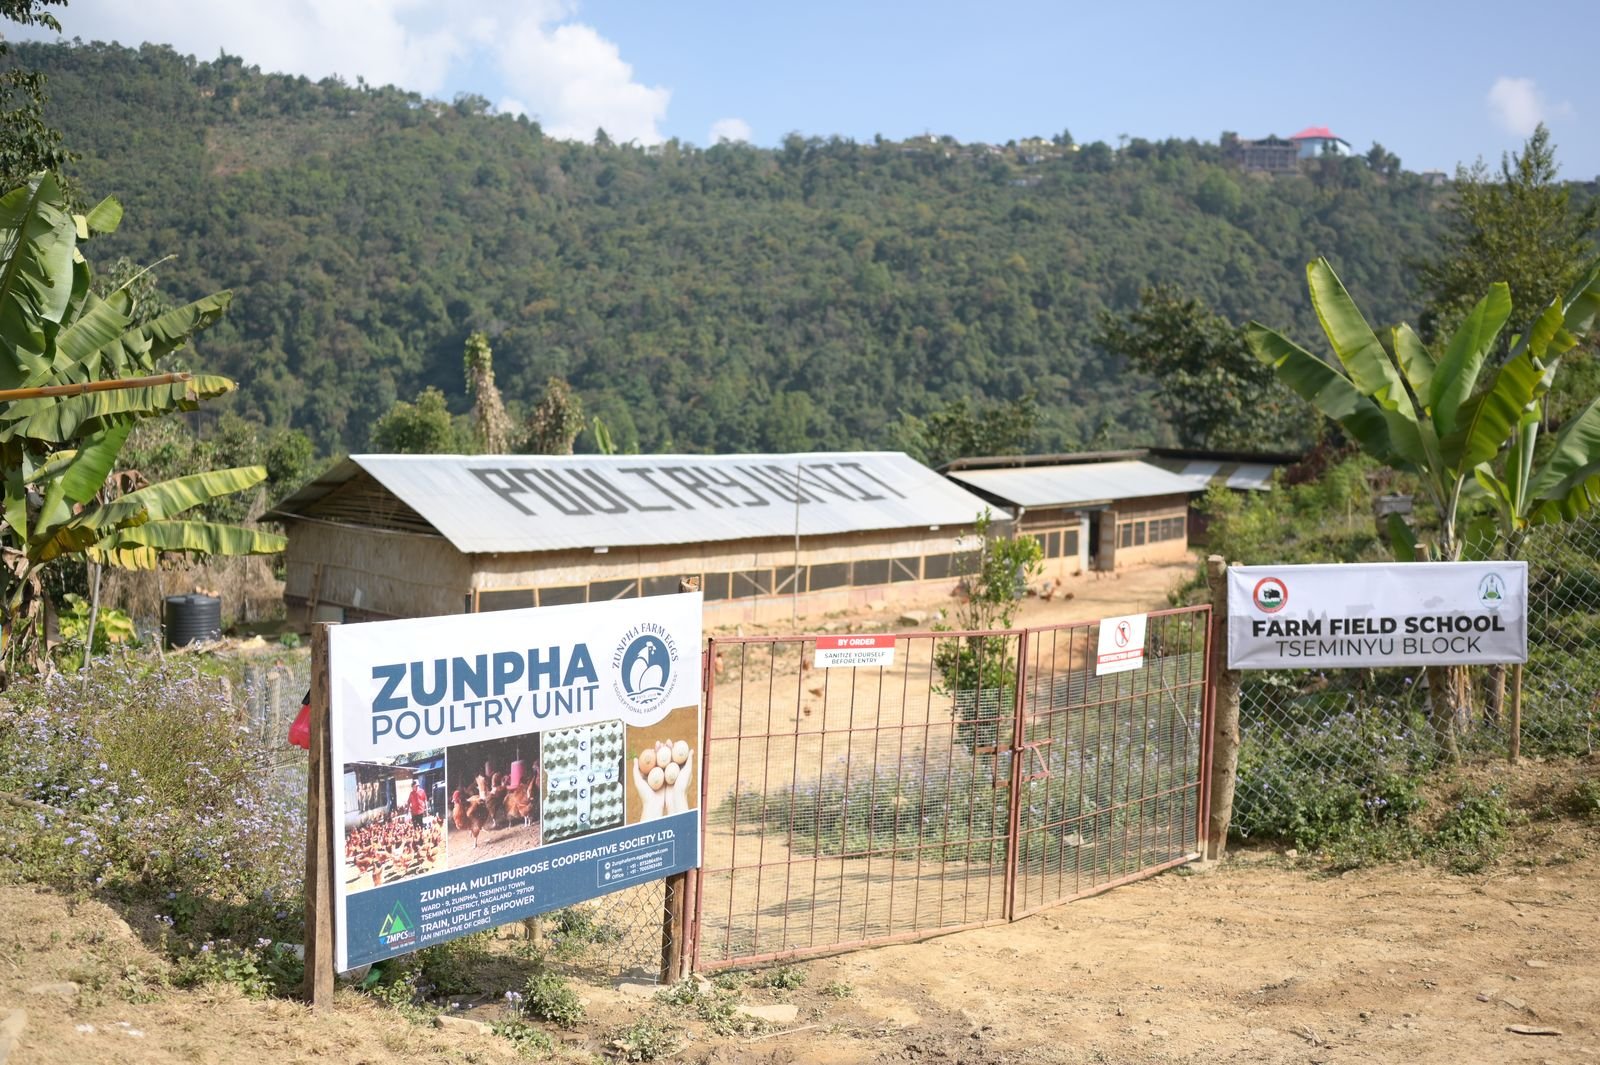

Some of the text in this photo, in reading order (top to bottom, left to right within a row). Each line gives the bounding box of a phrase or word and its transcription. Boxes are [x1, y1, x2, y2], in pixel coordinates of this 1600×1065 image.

[467, 462, 908, 516] POULTRY UNIT
[837, 638, 875, 646] BY ORDER
[1252, 615, 1505, 637] FARM FIELD SCHOOL
[612, 622, 678, 669] ZUNPHA FARM EGGS
[1276, 636, 1482, 657] TSEMINYU BLOCK
[372, 643, 599, 713] ZUNPHA
[372, 685, 599, 745] POULTRY UNIT
[420, 829, 676, 903] ZUNPHA MULTIPURPOSE COOPERATIVE SOCIETY LTD.
[420, 902, 441, 913] WARD
[451, 893, 478, 905] ZUNPHA,
[479, 886, 507, 897] TSEMINYU
[508, 880, 526, 890] TOWN
[421, 908, 452, 921] TSEMINYU
[452, 900, 480, 913] DISTRICT,
[480, 891, 512, 905] NAGALAND
[420, 894, 535, 933] TRAIN, UPLIFT & EMPOWER
[433, 924, 463, 937] INITIATIVE
[463, 922, 472, 930] OF
[386, 930, 409, 944] ZMPCS
